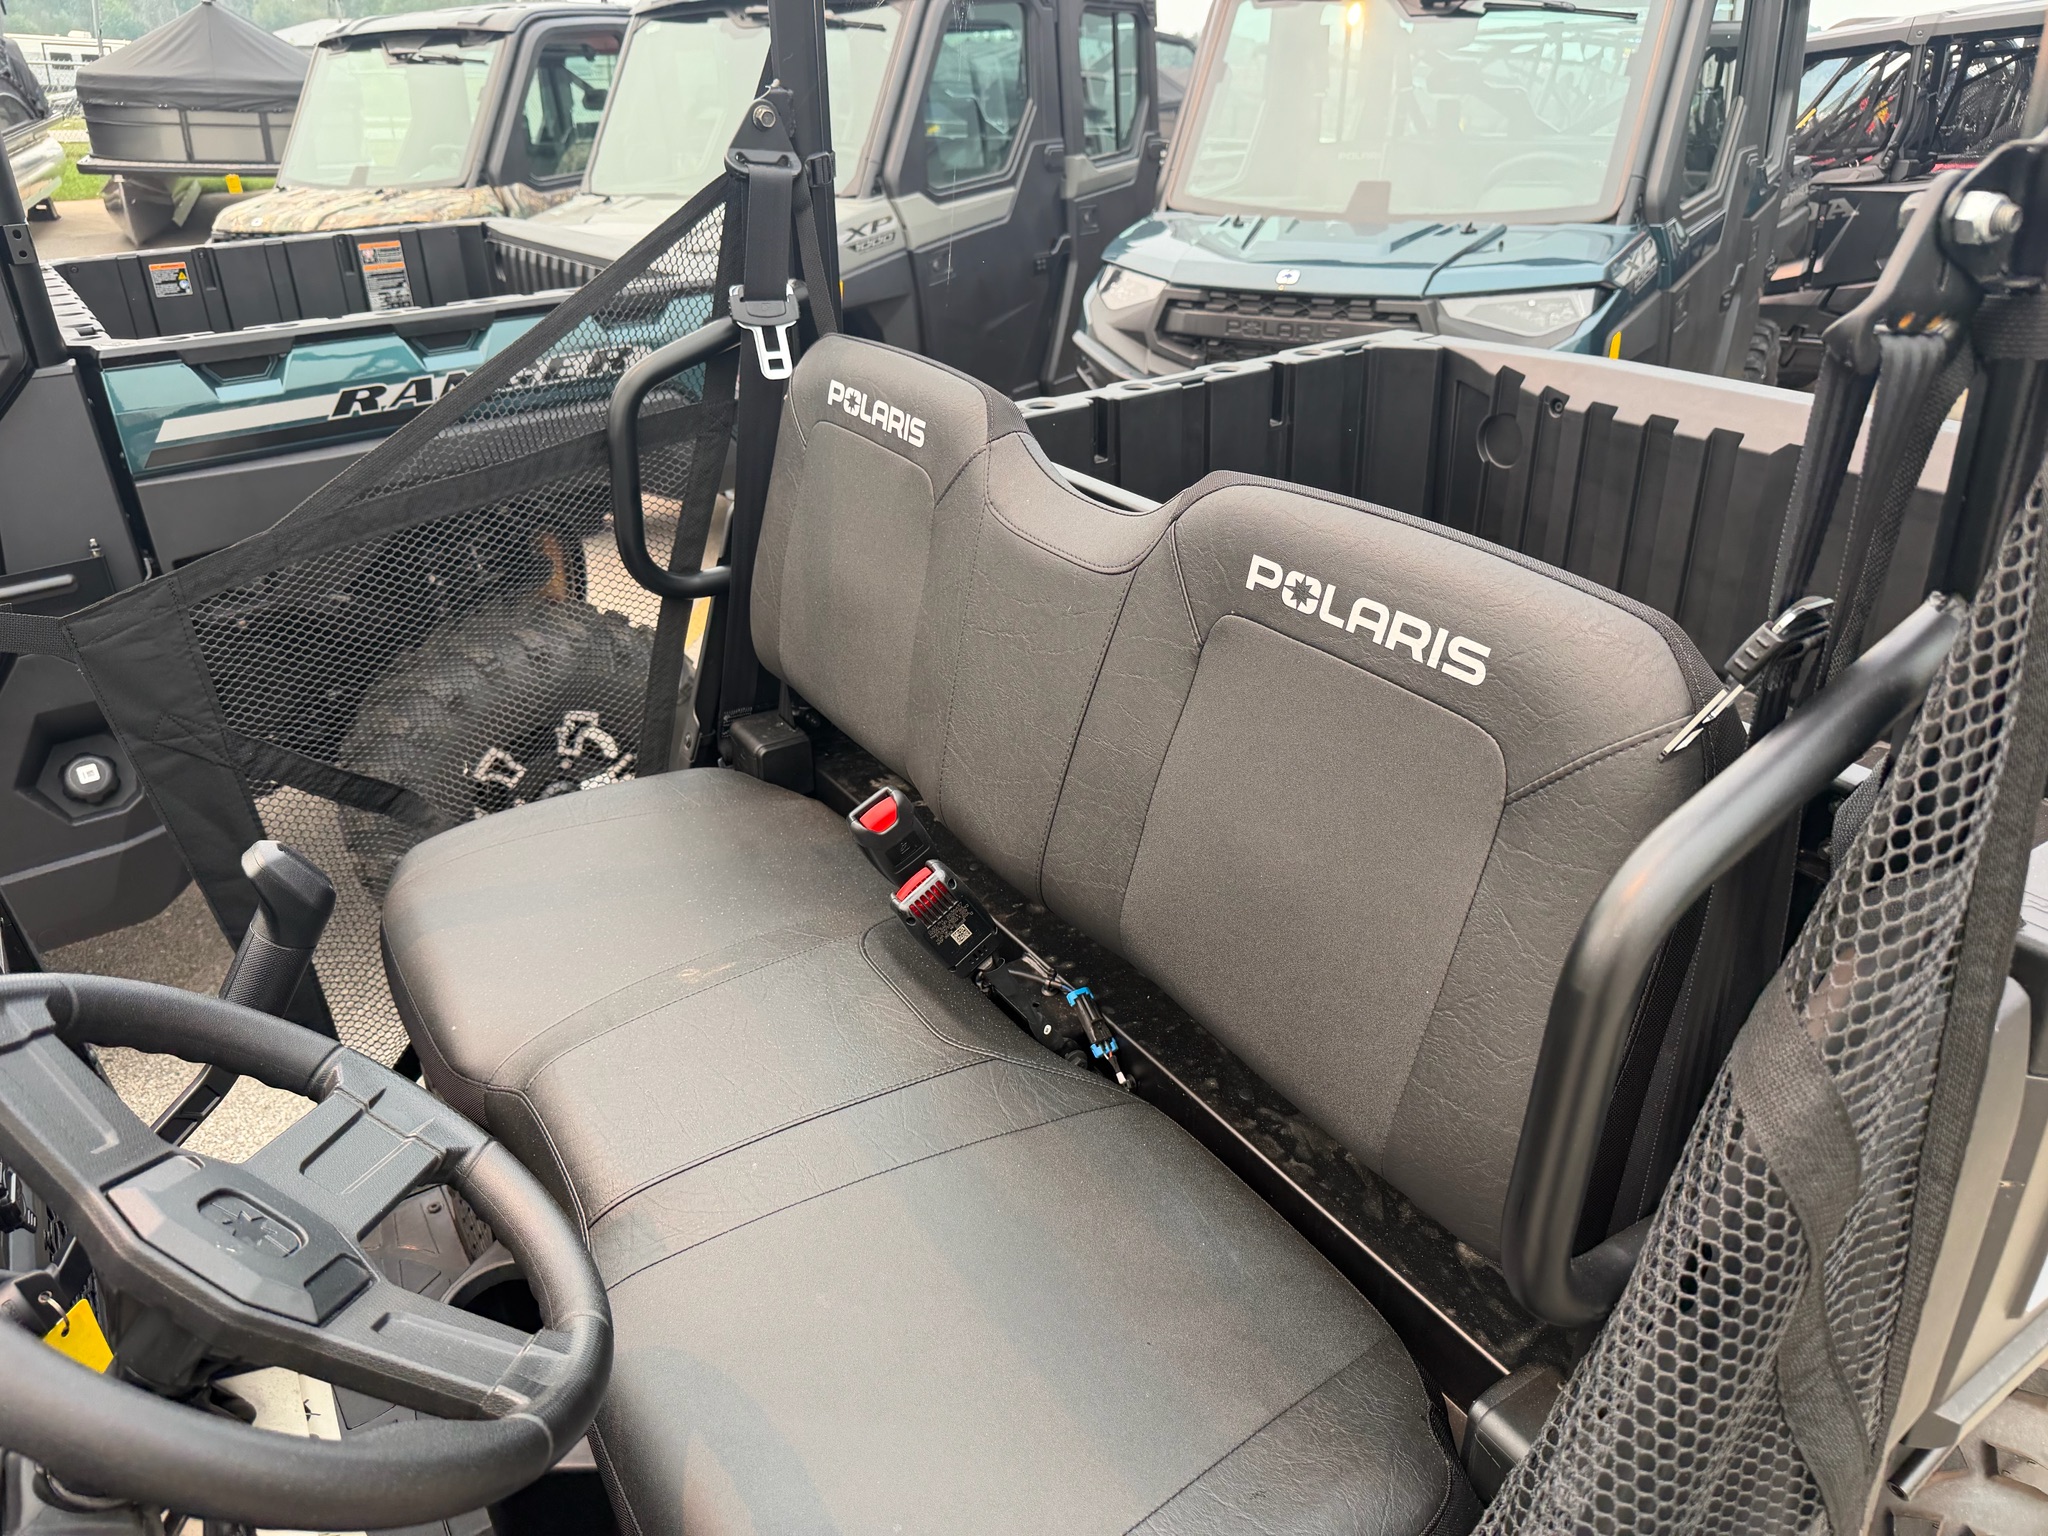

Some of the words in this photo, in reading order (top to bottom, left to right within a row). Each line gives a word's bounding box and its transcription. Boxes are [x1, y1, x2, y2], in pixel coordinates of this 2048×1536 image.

[844, 216, 893, 244] XP
[1624, 238, 1654, 281] XP
[827, 379, 927, 448] POLARIS
[1245, 554, 1492, 686] POLARIS
